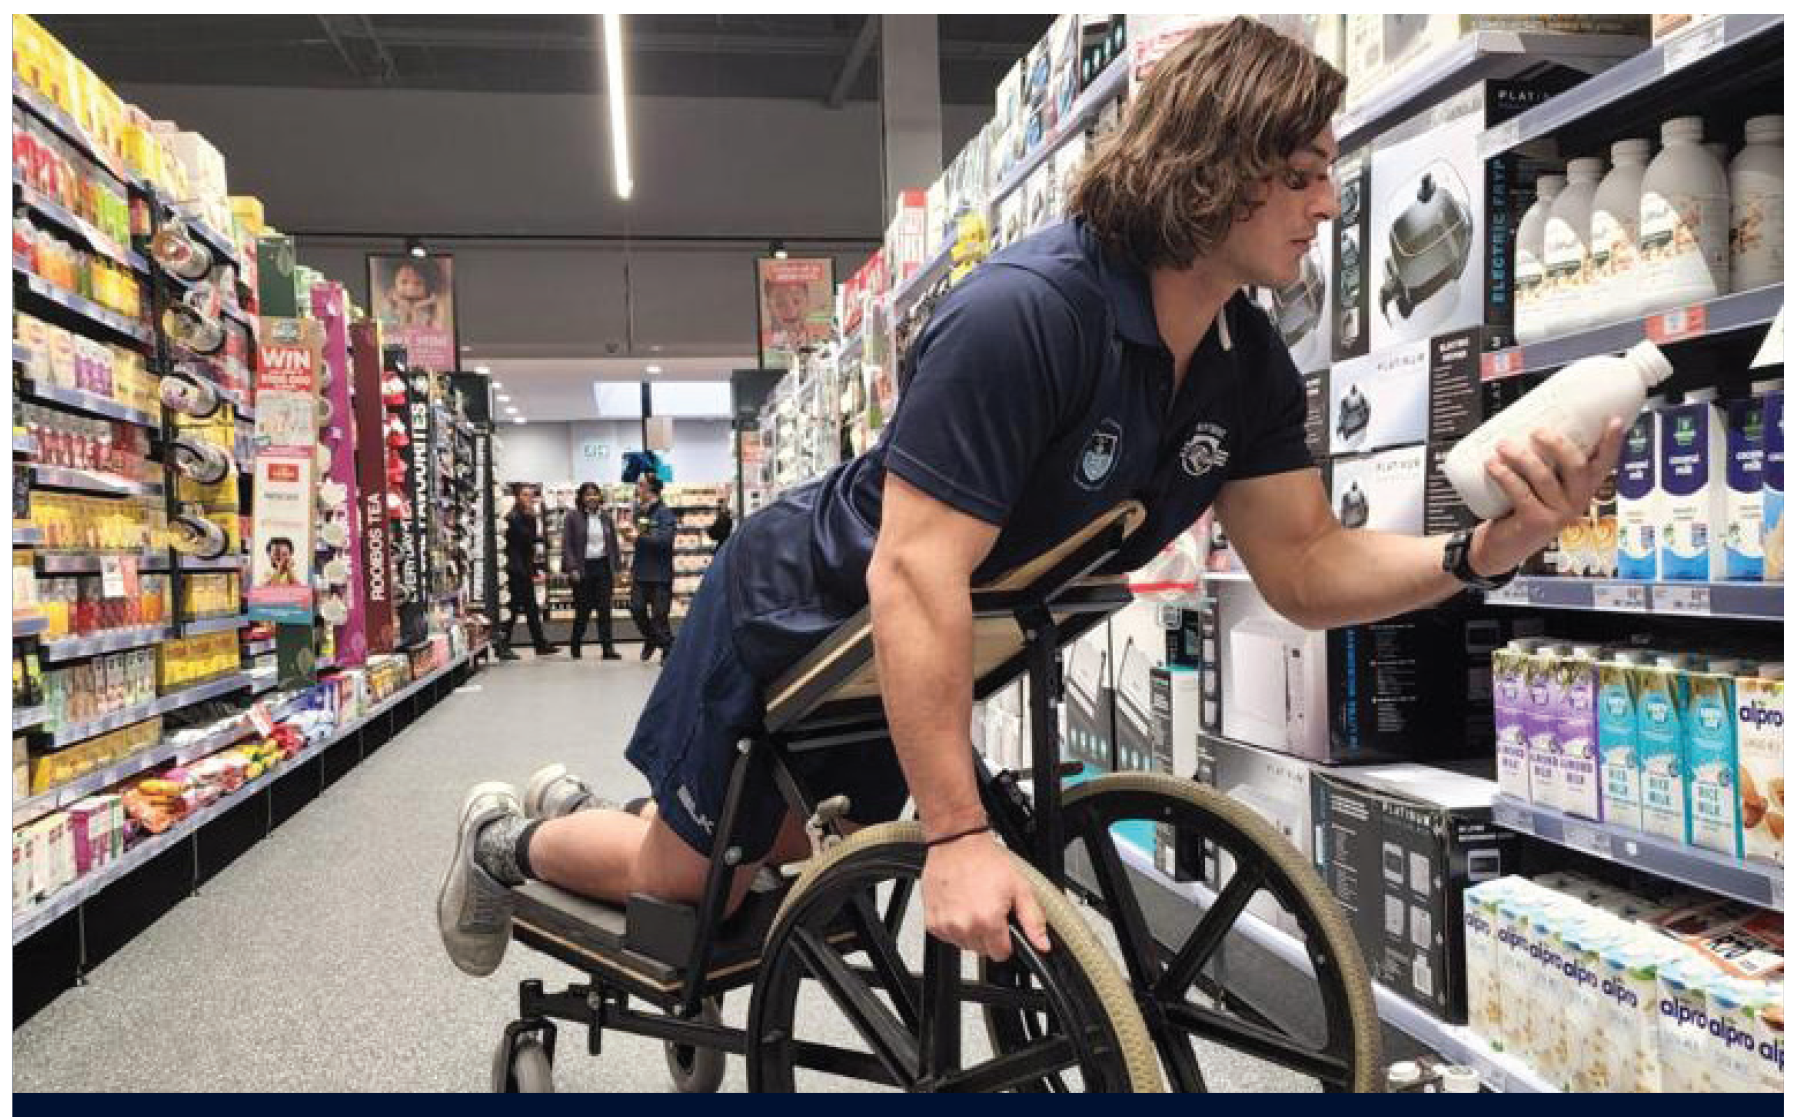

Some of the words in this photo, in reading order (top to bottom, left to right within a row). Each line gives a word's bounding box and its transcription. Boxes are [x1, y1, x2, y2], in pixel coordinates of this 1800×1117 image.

[260, 345, 310, 368] WIN
[367, 493, 382, 522] TEA
[369, 527, 385, 600] ROOIBOS
[1602, 976, 1637, 1008] alpro
[1661, 997, 1708, 1029] alpro
[1710, 1016, 1755, 1051] alpro
